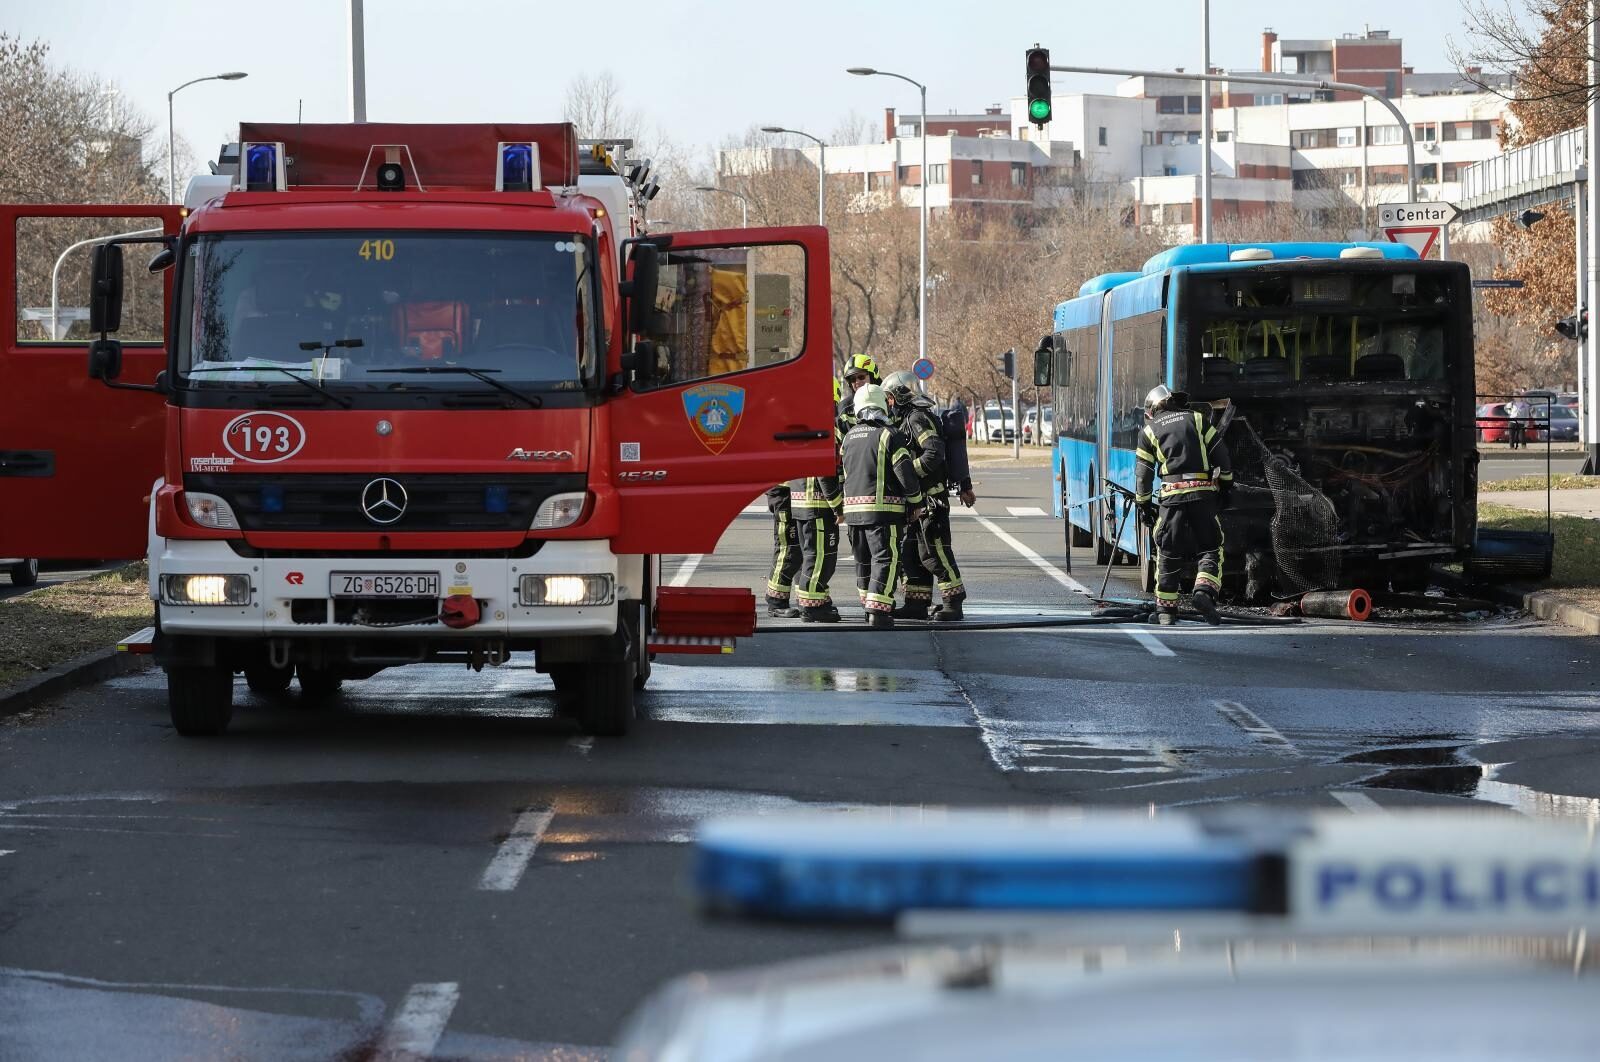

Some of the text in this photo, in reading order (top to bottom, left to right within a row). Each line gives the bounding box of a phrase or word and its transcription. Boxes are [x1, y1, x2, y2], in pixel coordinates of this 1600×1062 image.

[1396, 207, 1447, 222] Centar
[358, 239, 395, 261] 410
[242, 426, 290, 452] 193
[343, 576, 363, 593] ZG
